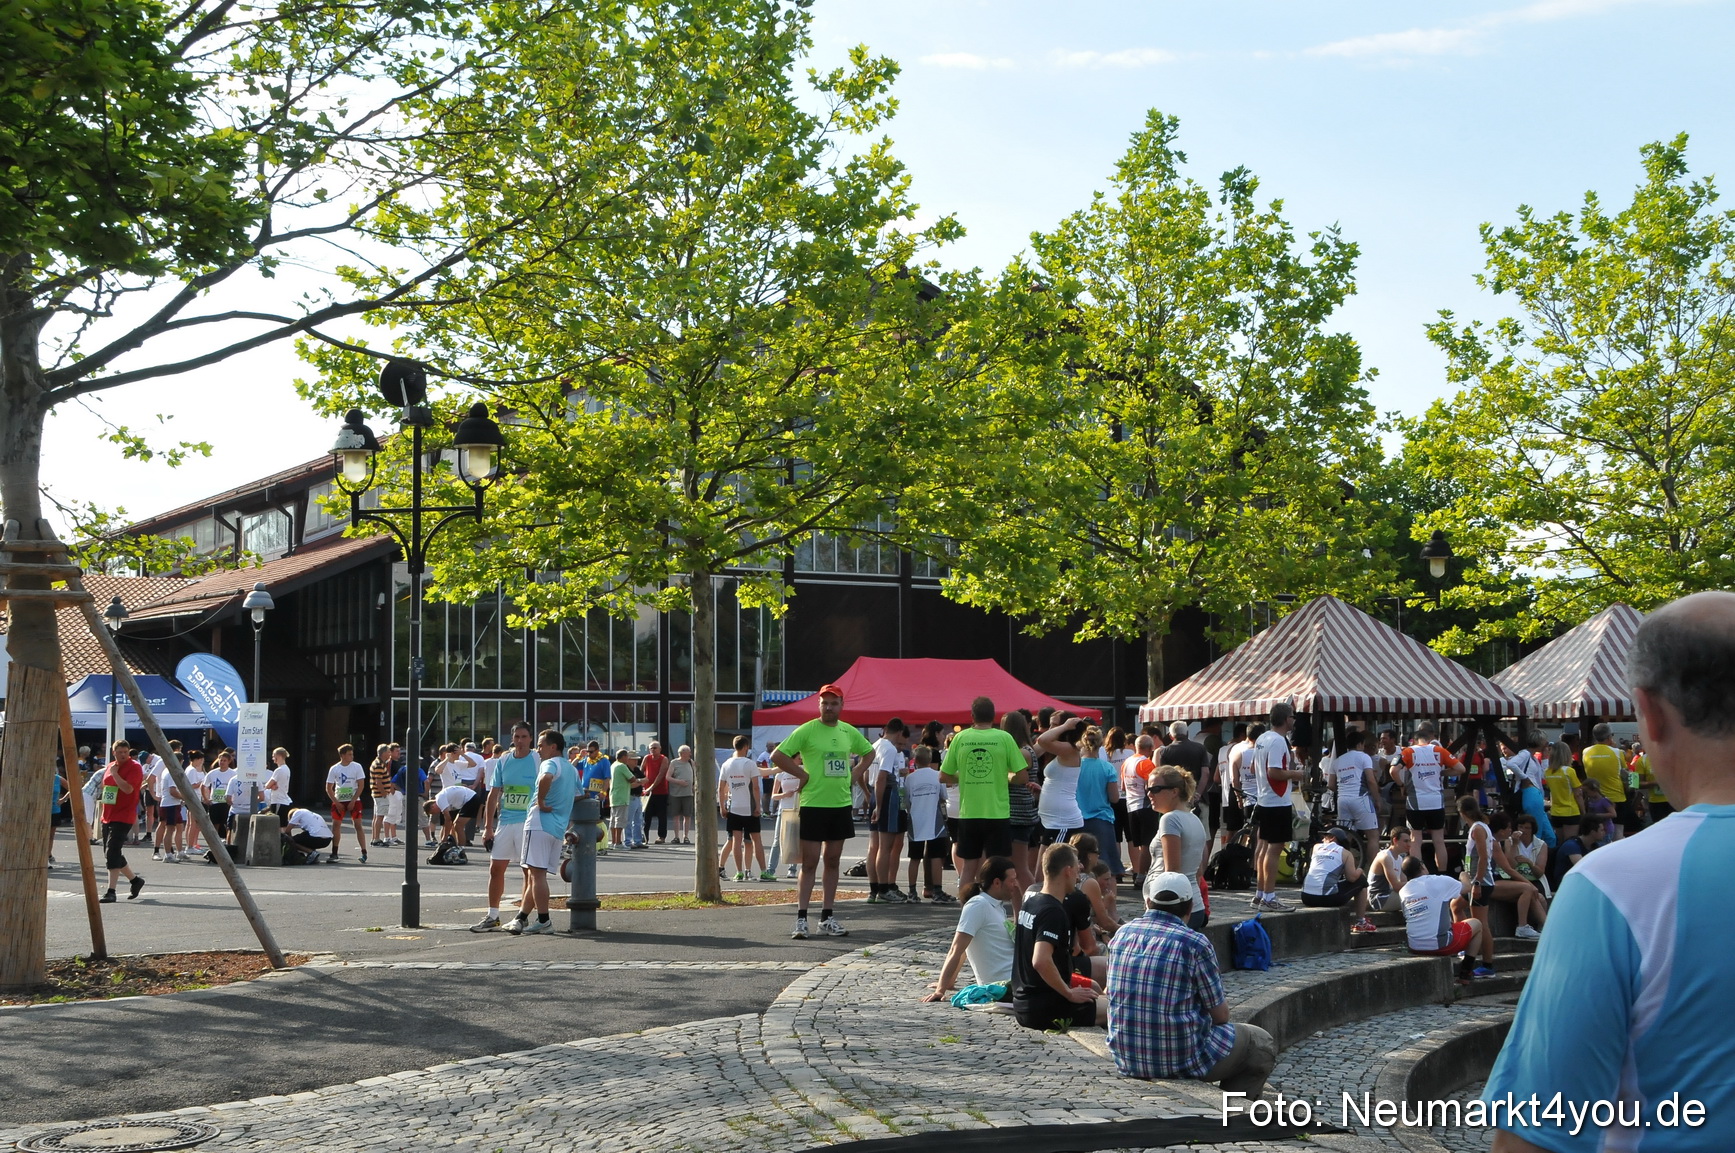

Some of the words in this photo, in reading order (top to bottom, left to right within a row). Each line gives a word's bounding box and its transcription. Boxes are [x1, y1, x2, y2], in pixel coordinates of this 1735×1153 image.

[241, 726, 252, 735] Zum
[252, 726, 264, 735] Start
[828, 760, 846, 771] 194
[505, 793, 529, 804] 1377
